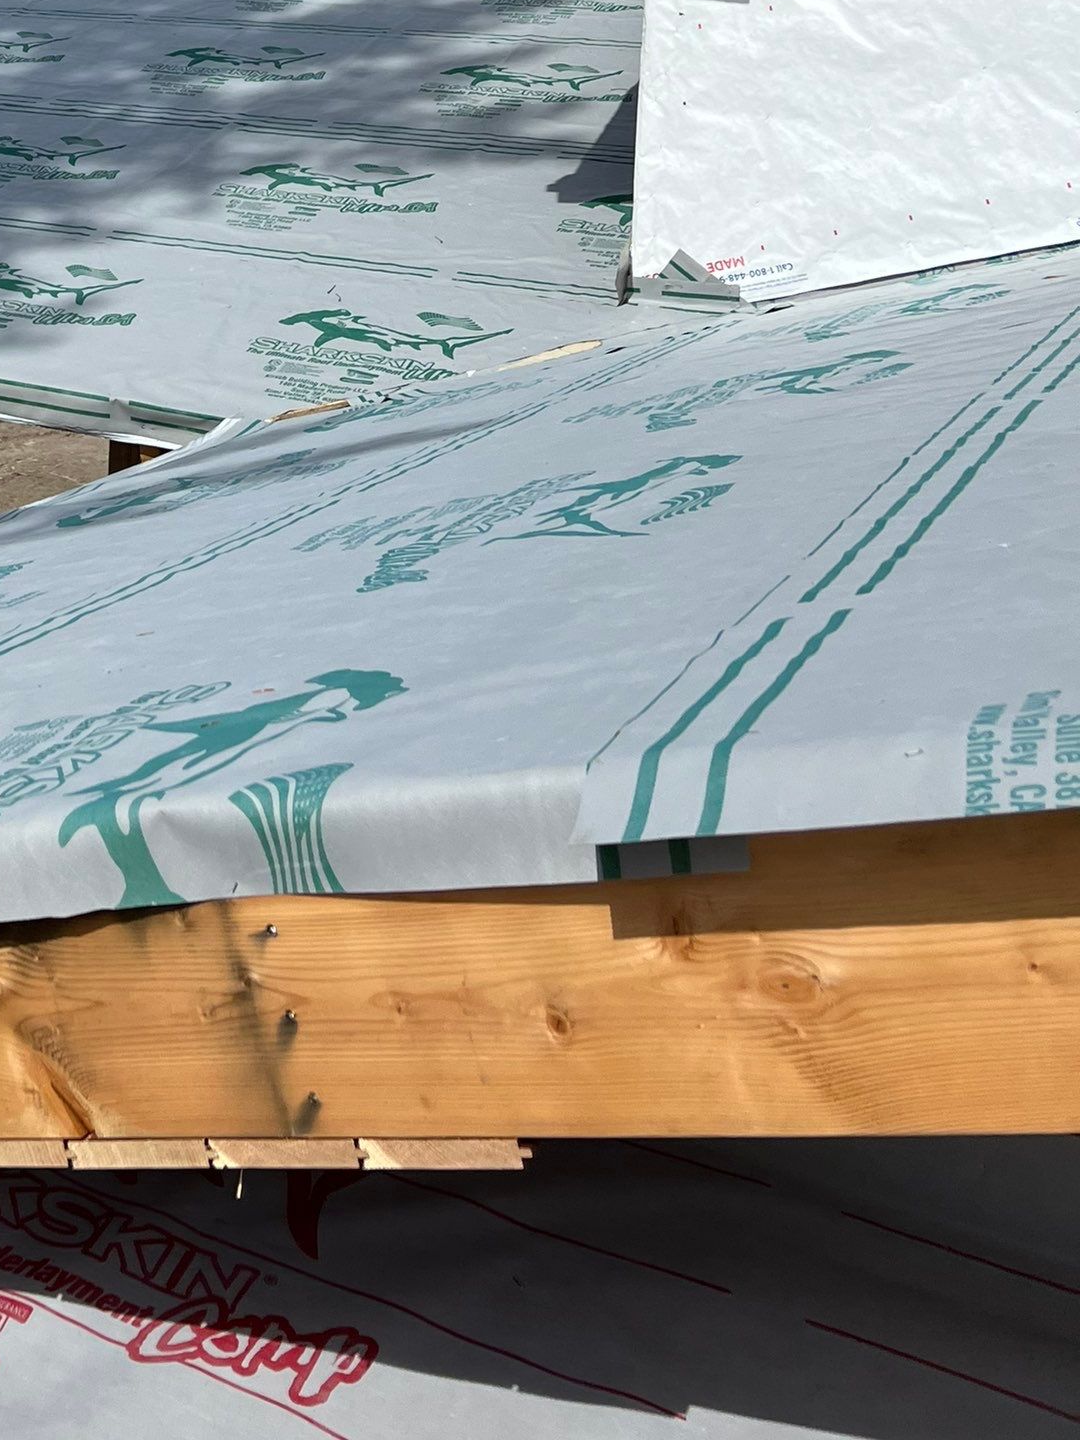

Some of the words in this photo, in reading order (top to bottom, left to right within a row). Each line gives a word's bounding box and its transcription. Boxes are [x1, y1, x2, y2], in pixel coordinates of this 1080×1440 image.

[706, 255, 745, 274] MADE
[776, 262, 794, 274] Call
[249, 336, 436, 371] SHARKSKIN
[1055, 771, 1080, 808] 38
